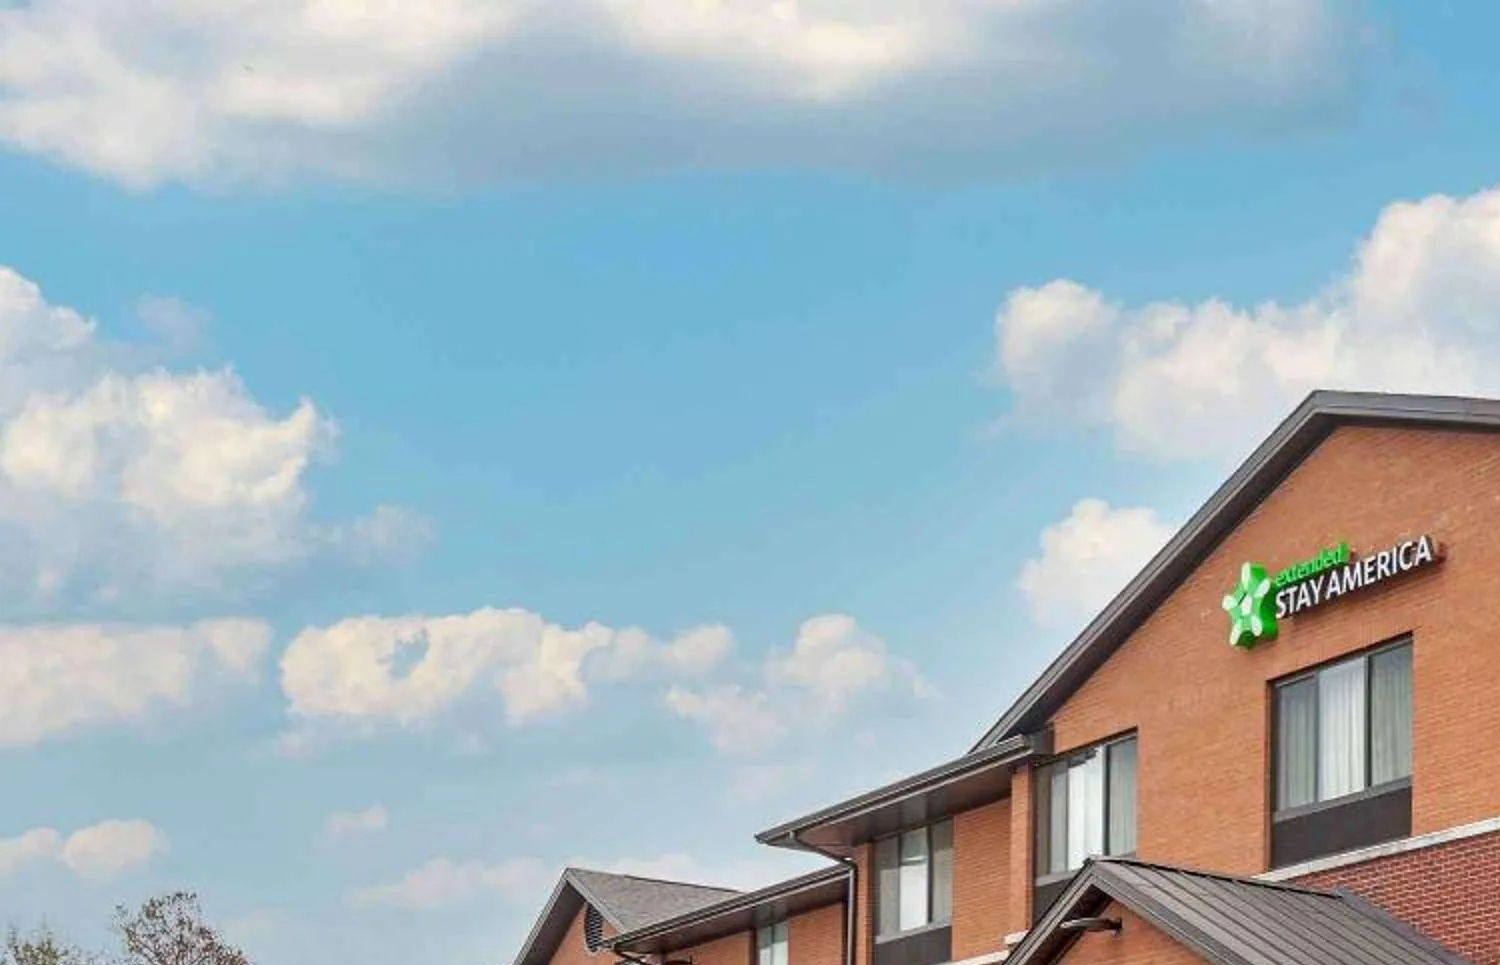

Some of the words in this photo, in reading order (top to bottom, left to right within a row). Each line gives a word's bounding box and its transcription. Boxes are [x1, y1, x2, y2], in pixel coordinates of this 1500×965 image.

[1275, 543, 1347, 587] extended
[1275, 575, 1324, 620] STAY
[1325, 535, 1433, 601] AMERICA
